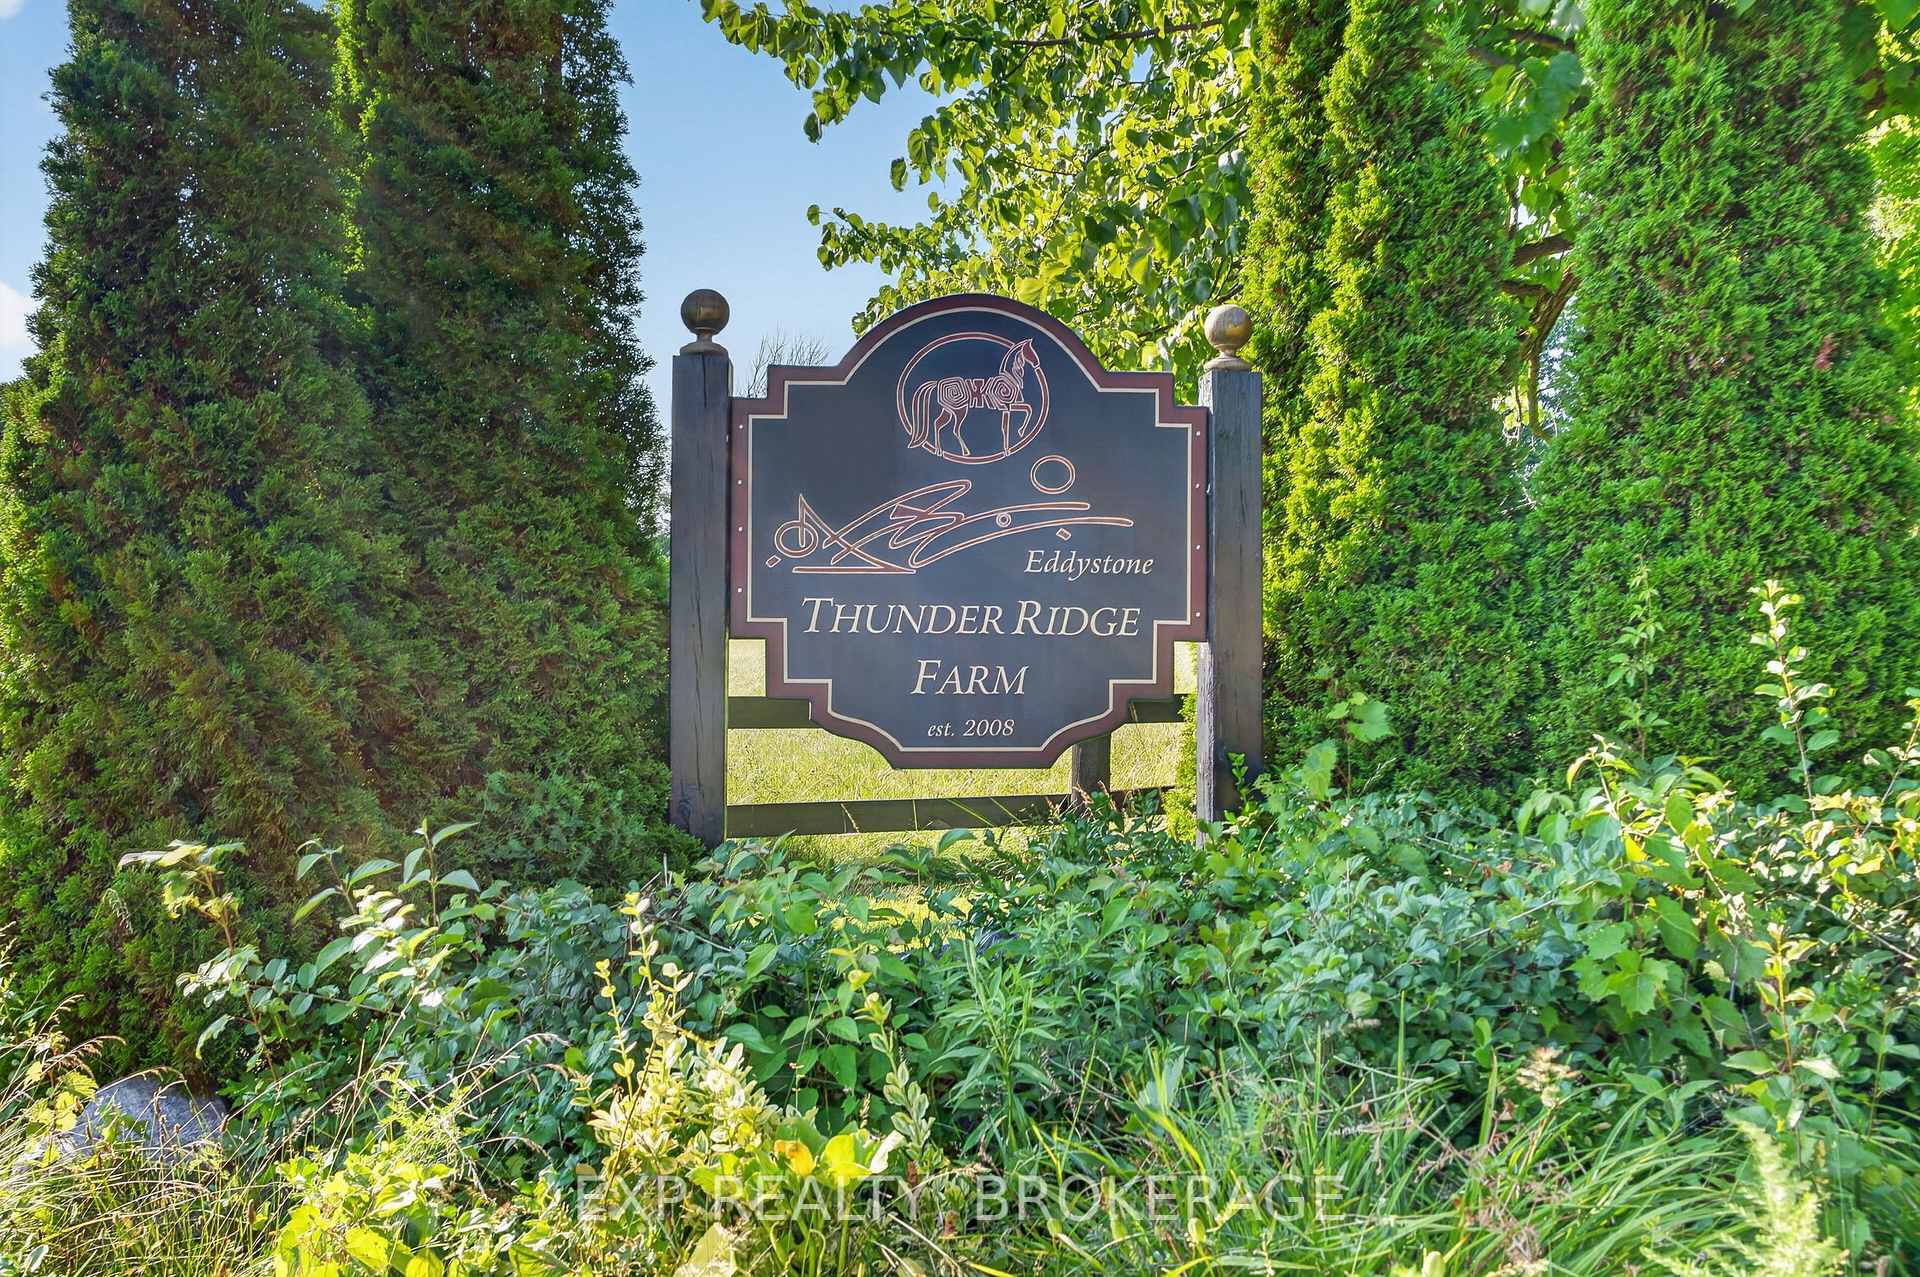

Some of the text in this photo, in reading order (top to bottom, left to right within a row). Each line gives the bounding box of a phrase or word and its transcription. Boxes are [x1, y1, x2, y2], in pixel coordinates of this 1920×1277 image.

[1024, 550, 1154, 582] Eddystone
[802, 597, 1141, 637] THUNDER RIDGE
[910, 660, 1029, 695] FARM
[927, 719, 1015, 737] est. 2008
